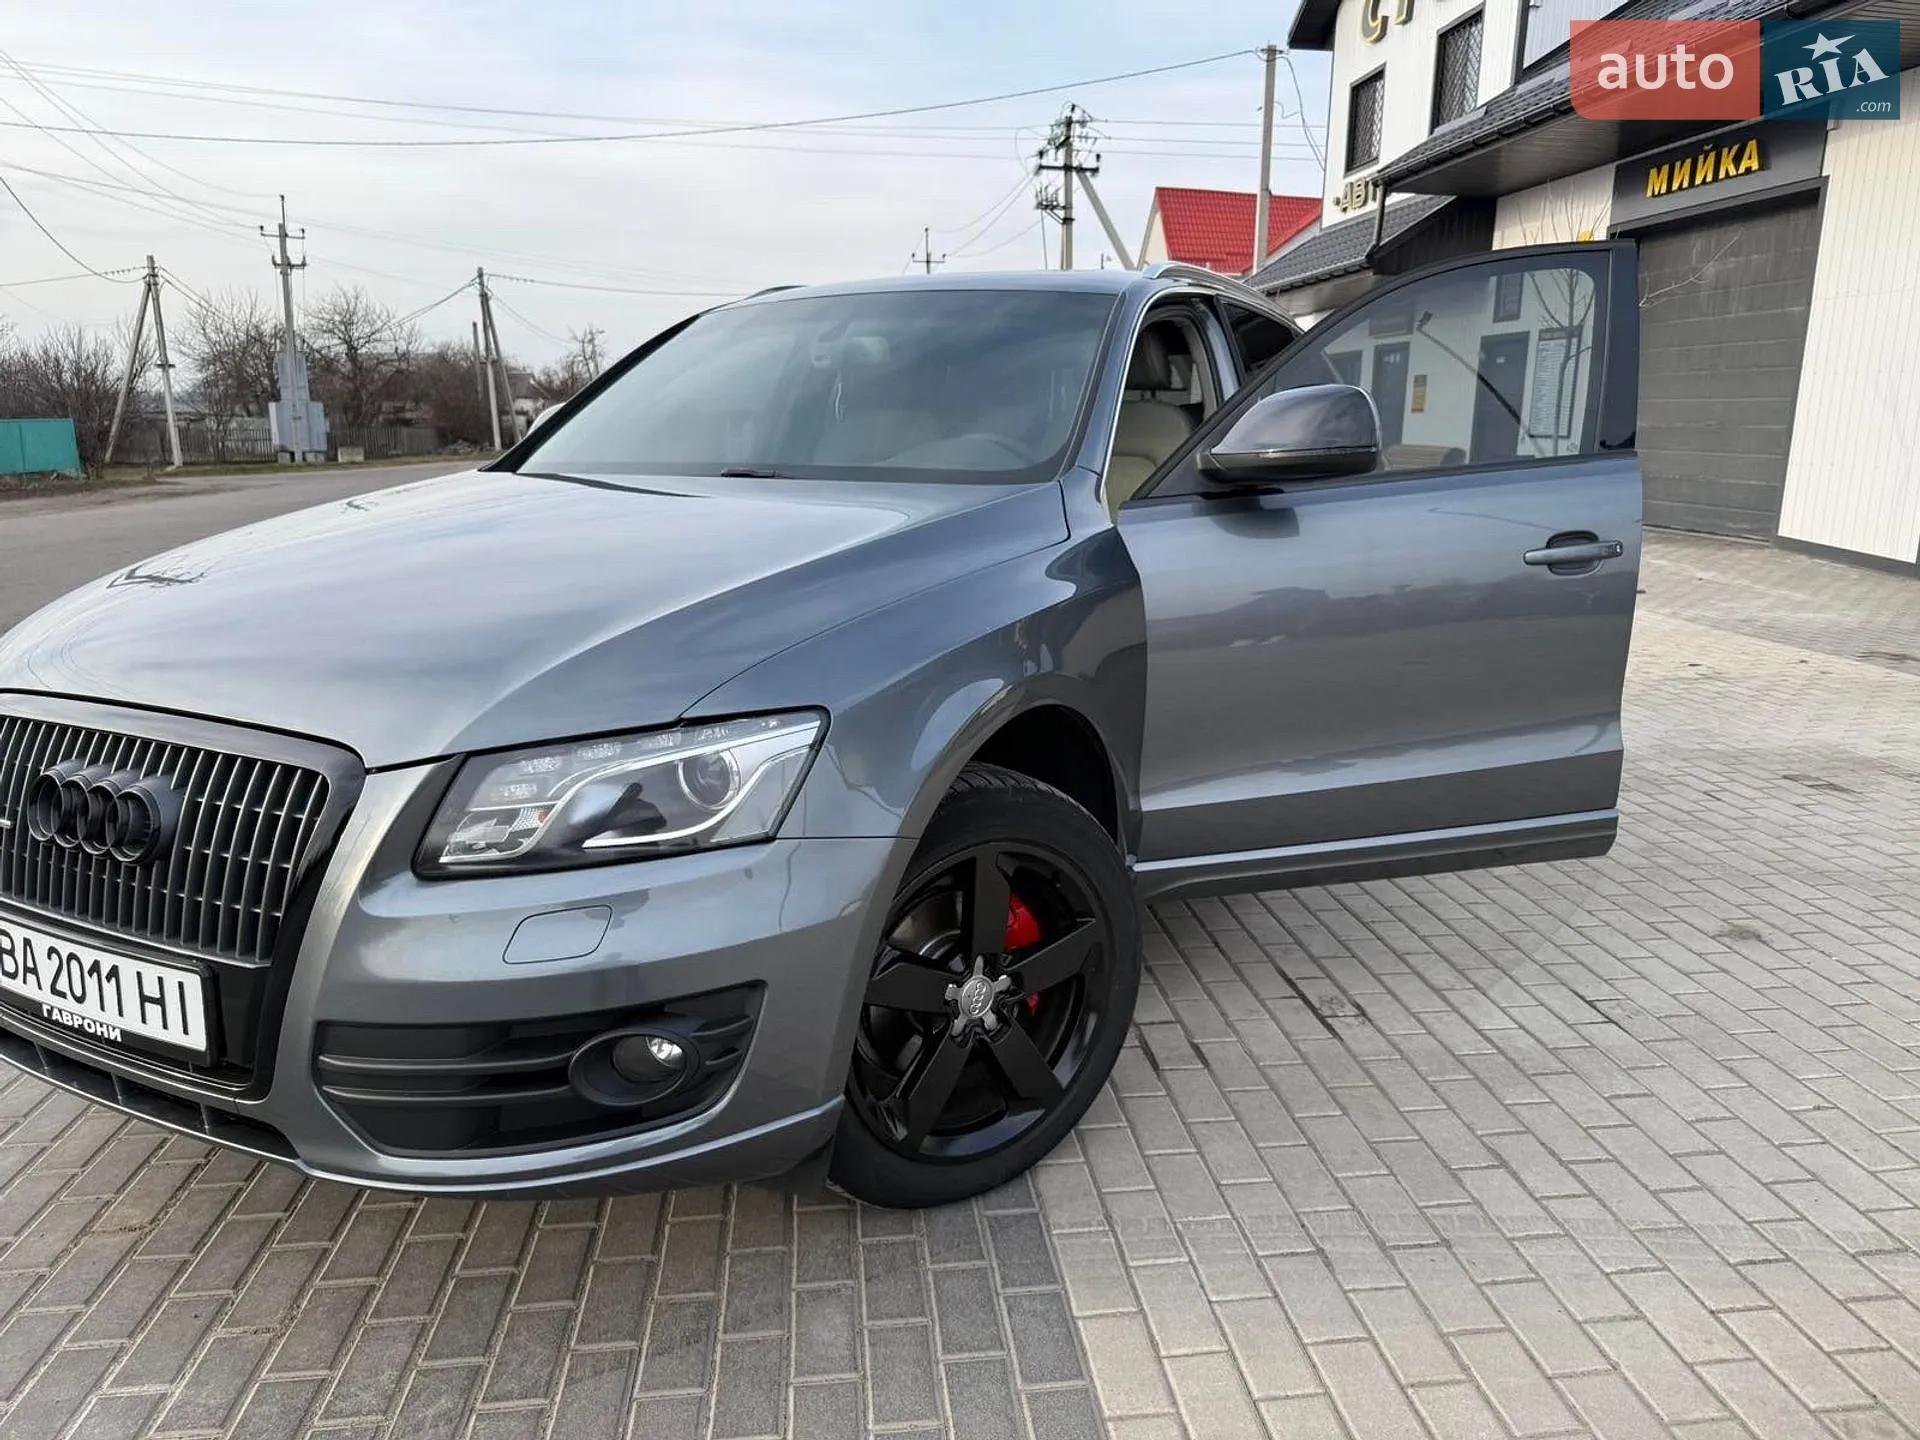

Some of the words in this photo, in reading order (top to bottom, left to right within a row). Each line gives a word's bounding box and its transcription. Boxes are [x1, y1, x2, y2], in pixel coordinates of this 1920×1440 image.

[1646, 139, 1760, 198] МИЙКА
[47, 945, 124, 1018] 2011
[42, 1003, 123, 1042] ГАВРОНИ
